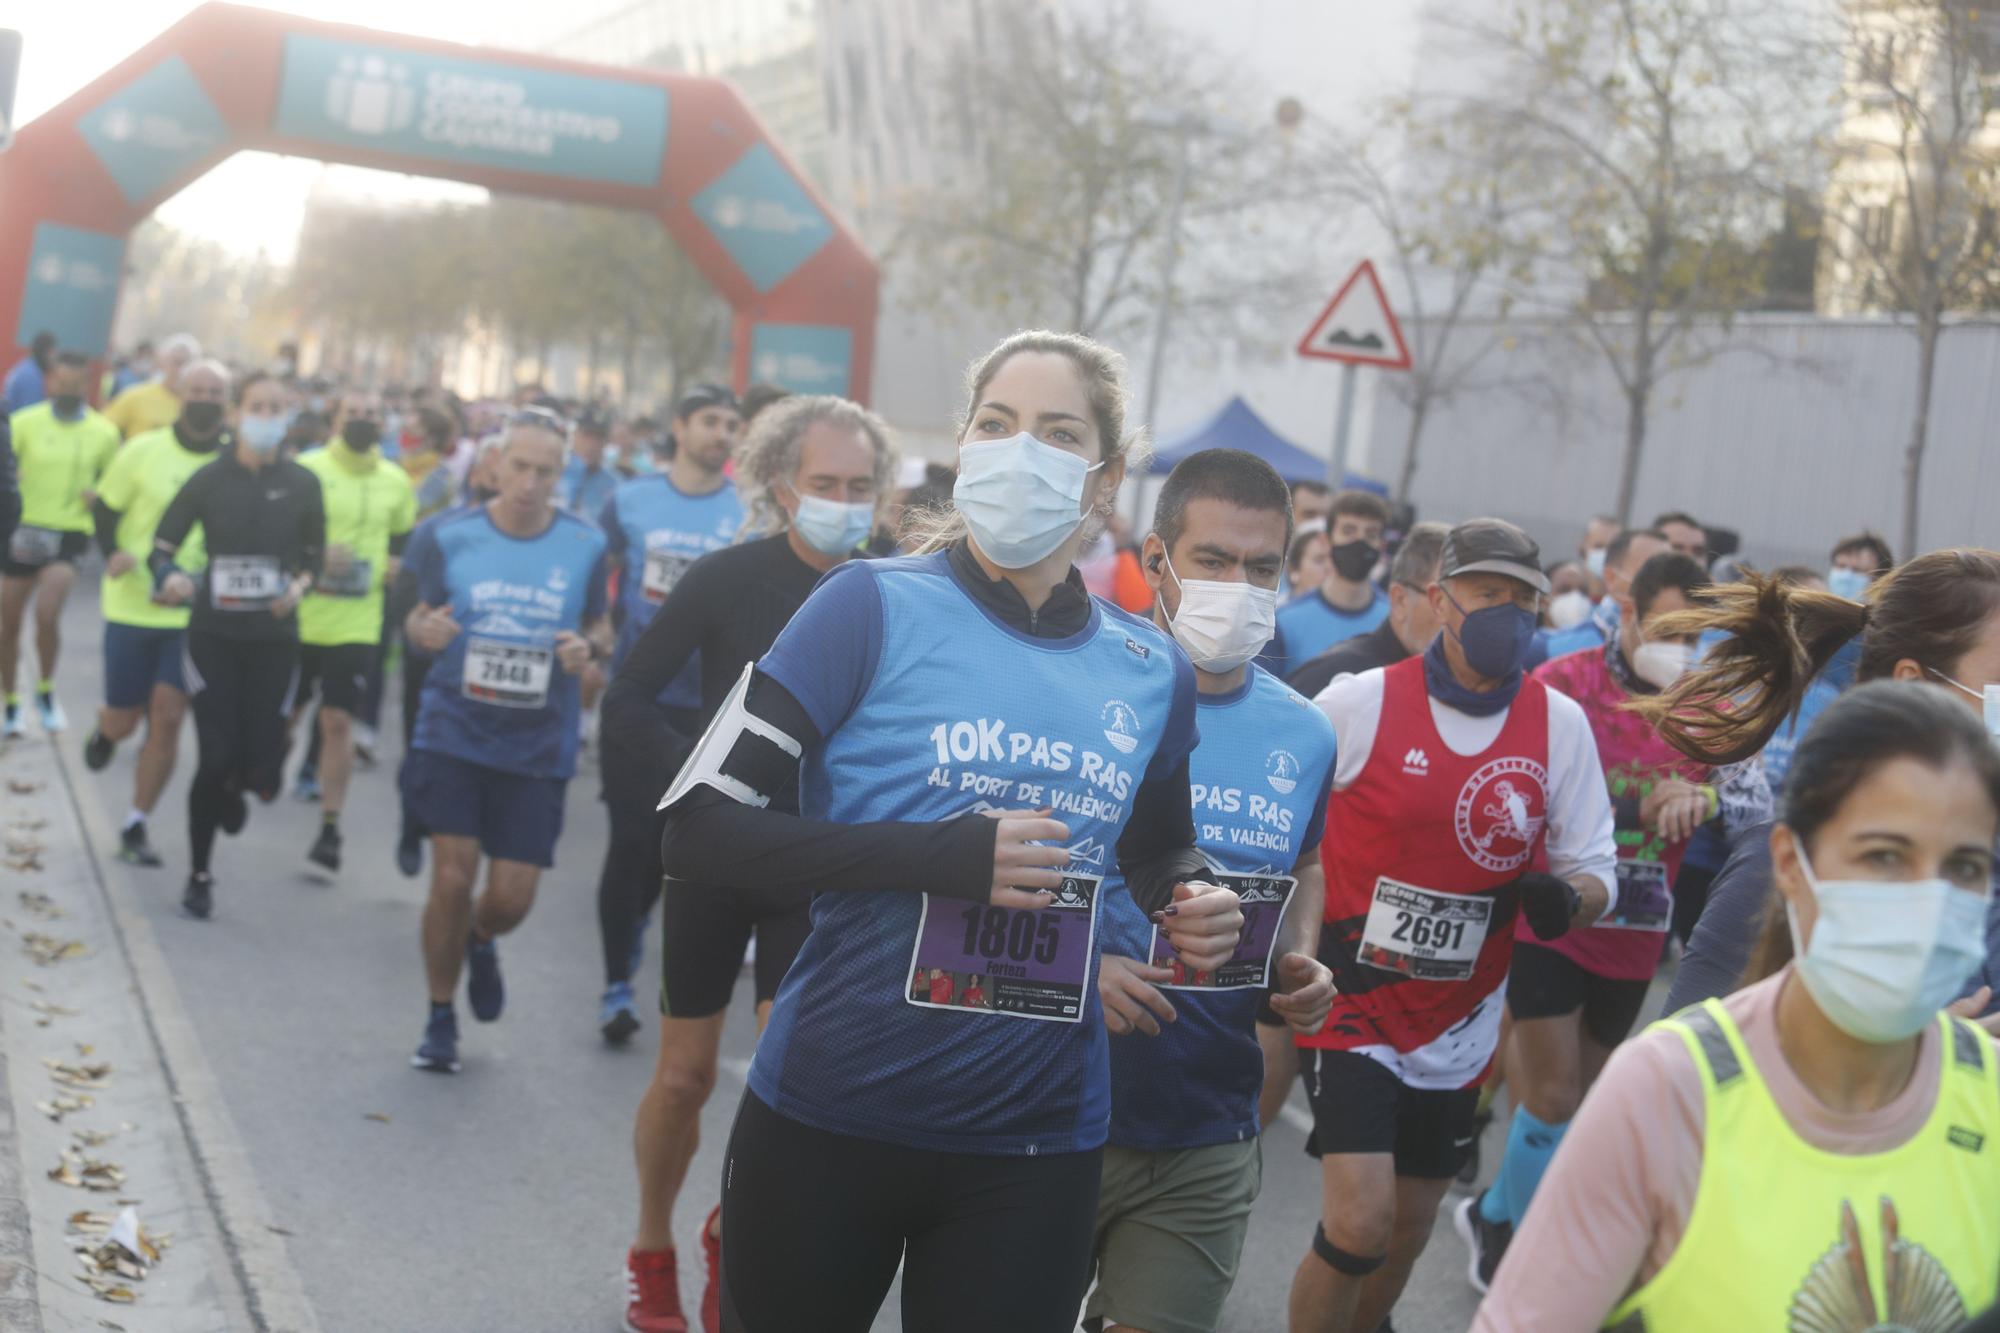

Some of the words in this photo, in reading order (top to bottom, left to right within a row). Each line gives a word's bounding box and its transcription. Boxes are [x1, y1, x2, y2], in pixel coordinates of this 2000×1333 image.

[425, 71, 525, 106] GRUPO
[420, 118, 553, 157] CAJAMAR
[423, 94, 620, 143] COOPERATIVO
[930, 718, 1006, 764] 10K
[1008, 732, 1073, 771] PAS
[1079, 751, 1133, 801] RAS
[928, 767, 951, 787] AL
[960, 772, 1013, 798] PORT
[1016, 783, 1044, 805] DE
[1051, 788, 1122, 824] VALÈNCIA
[1191, 784, 1242, 813] PAS
[1249, 794, 1294, 833] RAS
[1202, 824, 1224, 842] DE
[1230, 825, 1290, 853] VALÈNCIA
[961, 905, 1062, 965] 1805
[1391, 911, 1465, 950] 2691
[986, 960, 1027, 977] Forteza
